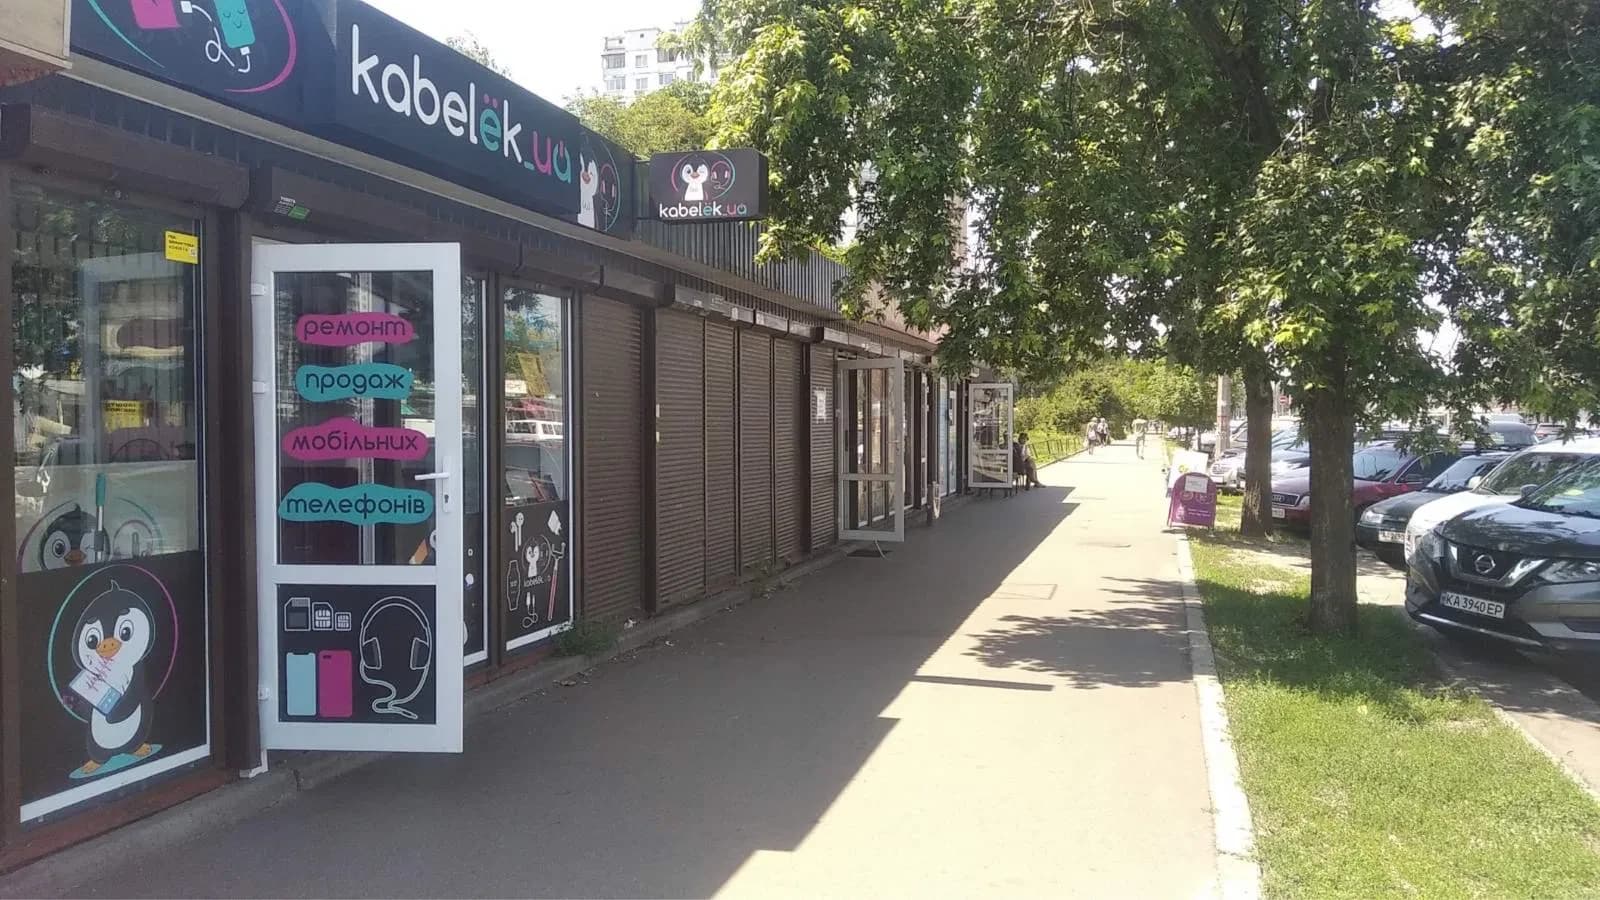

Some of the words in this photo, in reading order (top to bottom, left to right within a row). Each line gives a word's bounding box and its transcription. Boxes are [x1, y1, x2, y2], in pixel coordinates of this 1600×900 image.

[304, 320, 406, 341] ремонт
[305, 373, 405, 395] продаж
[292, 430, 418, 451] мобільних
[286, 493, 425, 519] телефонів
[1462, 597, 1486, 613] 3940
